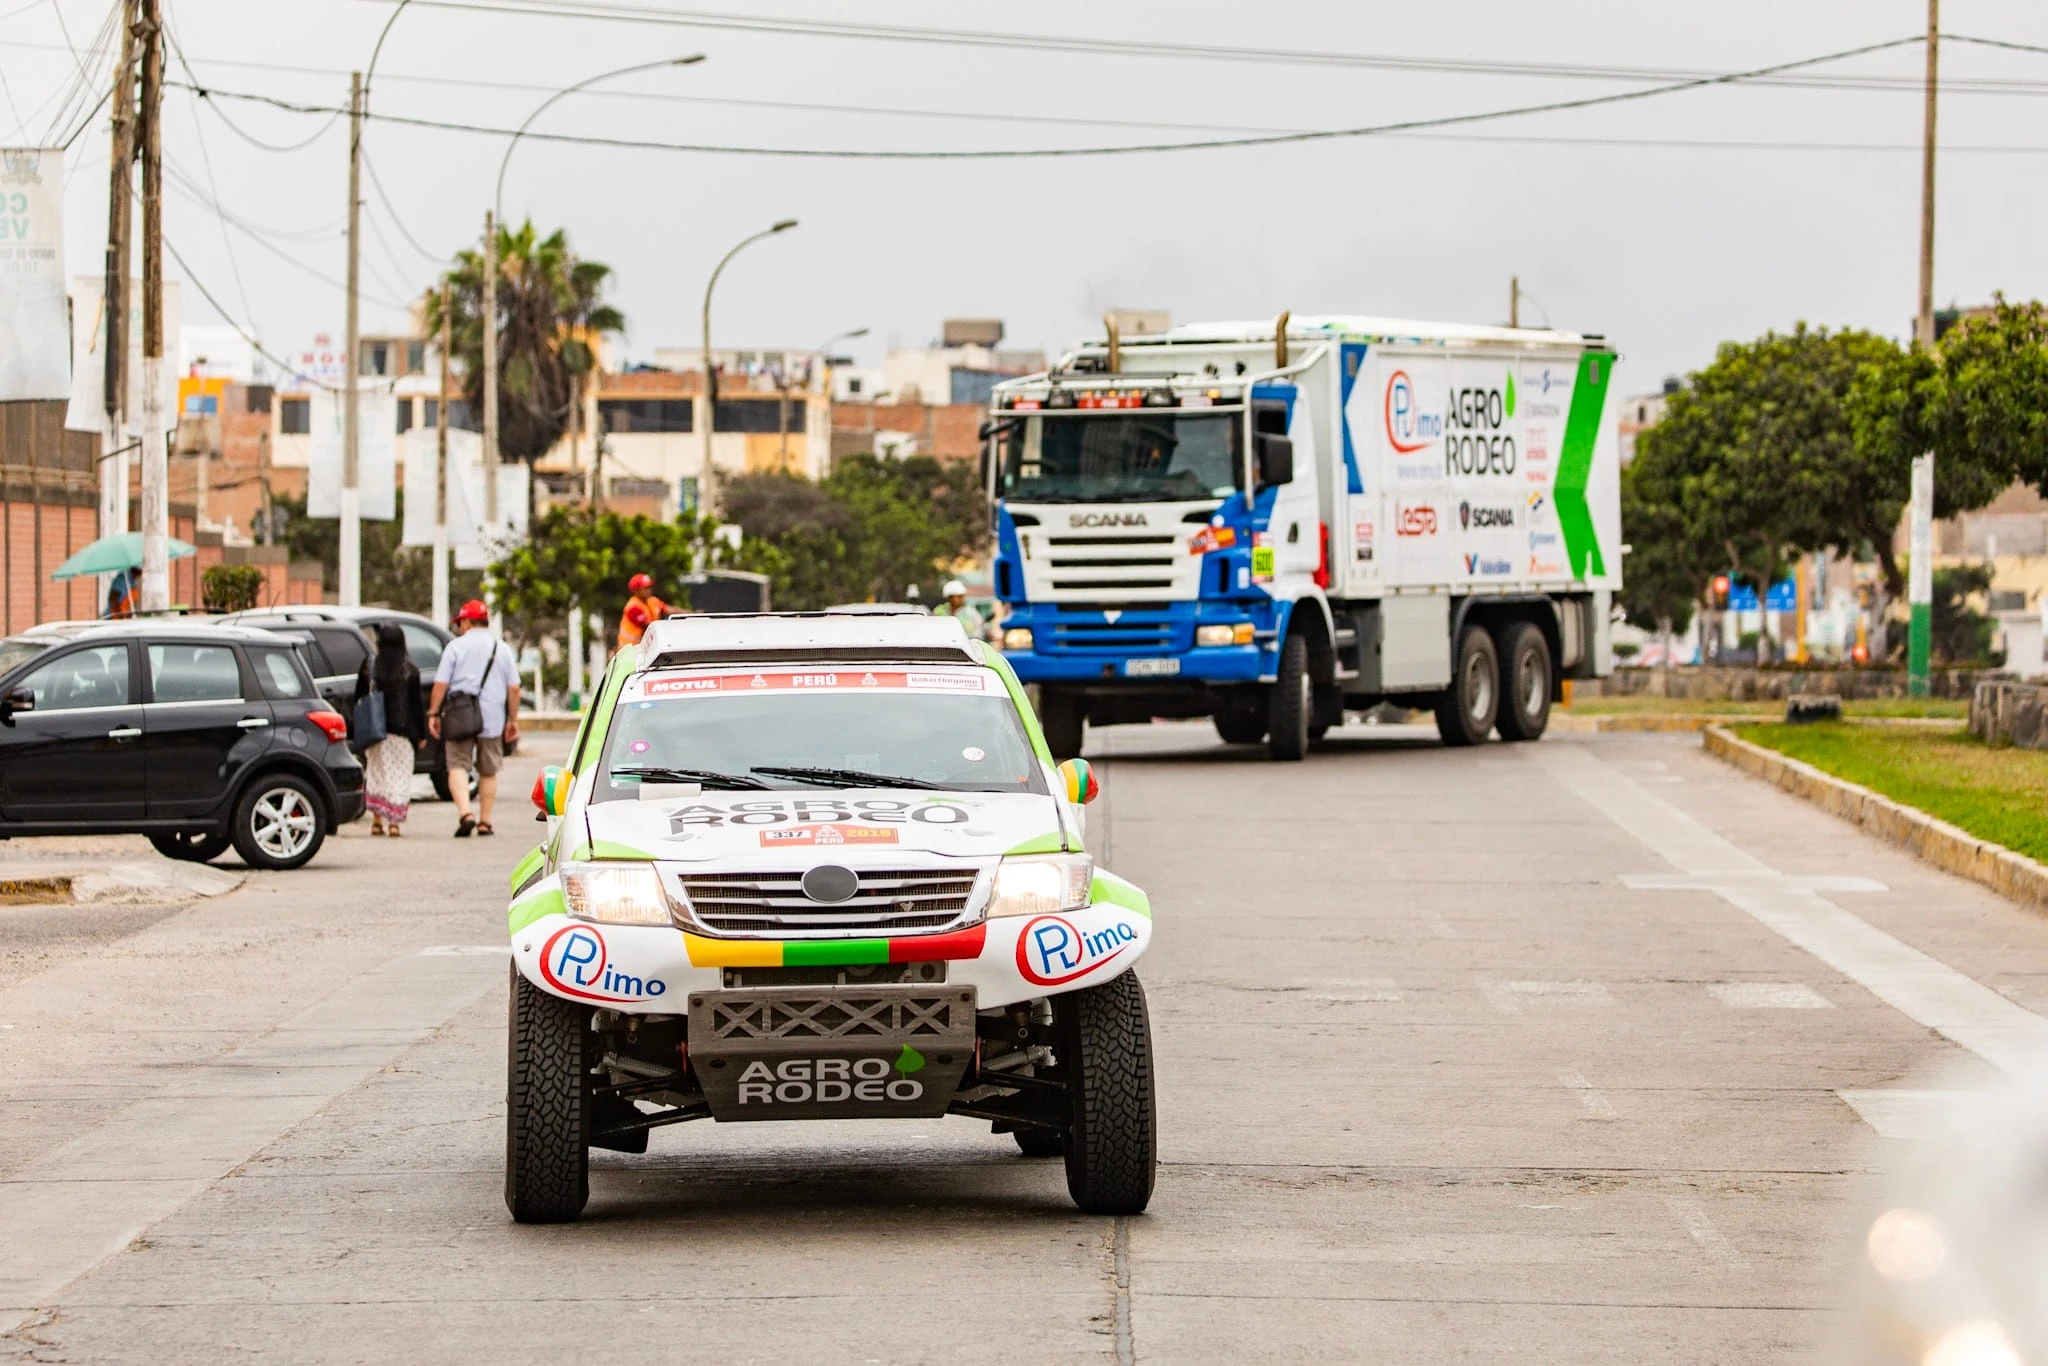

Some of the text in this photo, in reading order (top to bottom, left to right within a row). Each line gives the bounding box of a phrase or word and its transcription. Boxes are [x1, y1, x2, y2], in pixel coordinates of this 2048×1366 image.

[1445, 388, 1502, 429] AGRO
[1445, 435, 1516, 476] RODEO
[1069, 513, 1149, 528] SCANIA
[1472, 508, 1515, 528] SCANIA
[651, 679, 717, 692] MOTUL
[792, 673, 838, 687] PERÚ
[669, 800, 911, 817] AGRO
[669, 804, 969, 835] RODEO
[772, 831, 803, 839] 337
[737, 1058, 890, 1082] AGRO
[738, 1079, 924, 1105] RODEO
